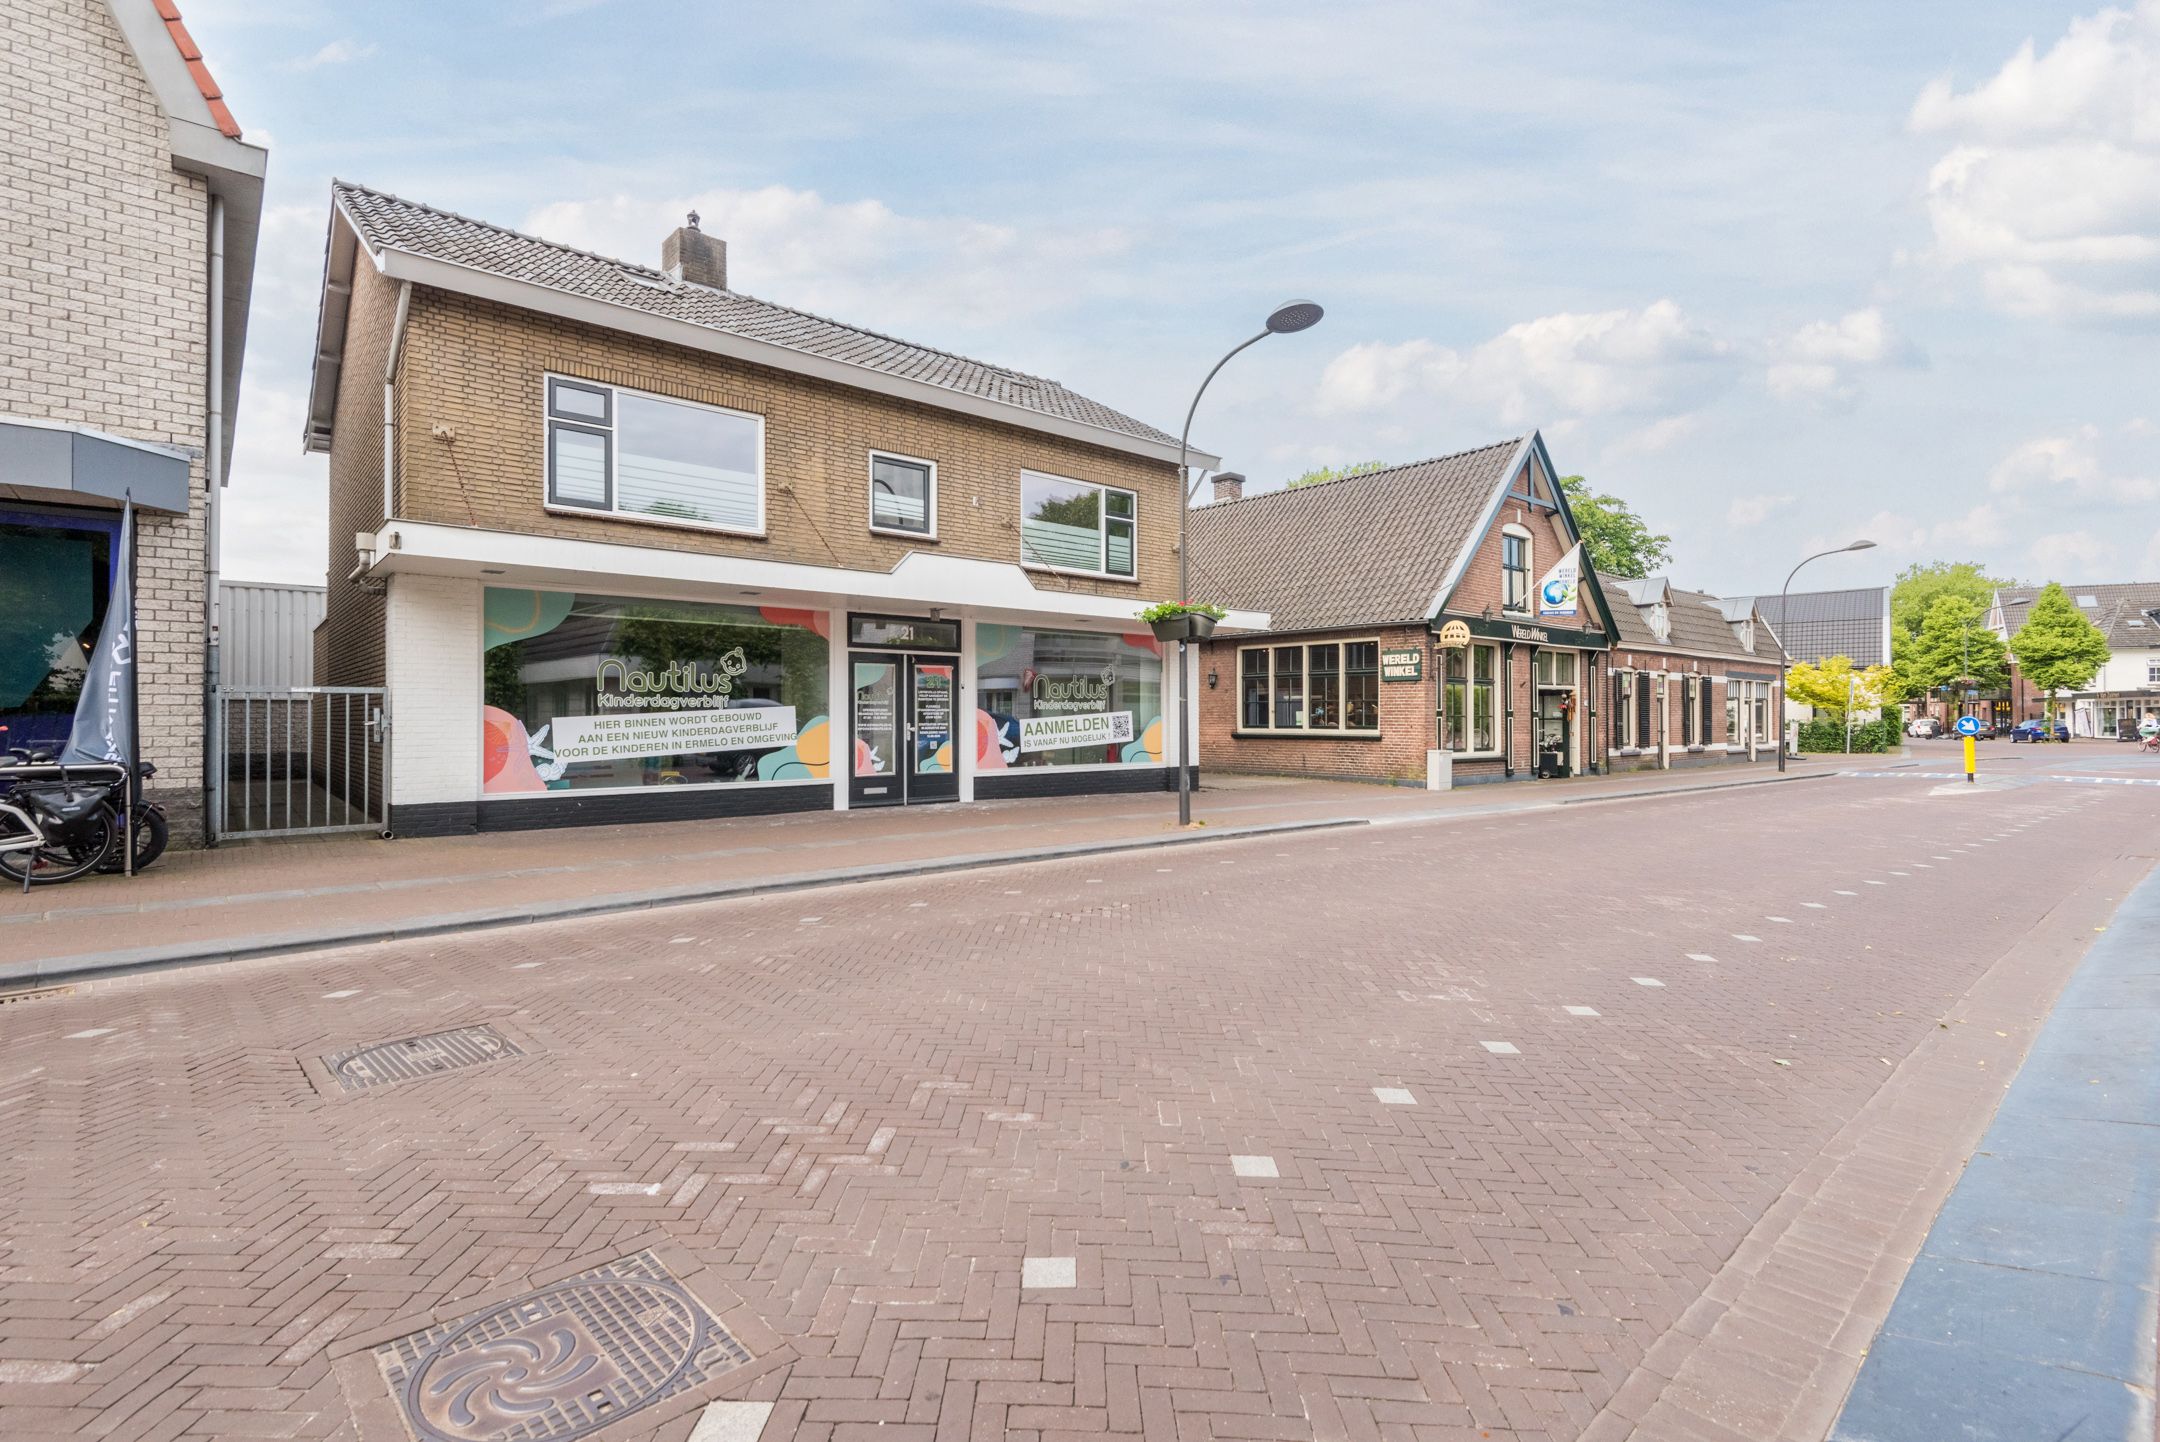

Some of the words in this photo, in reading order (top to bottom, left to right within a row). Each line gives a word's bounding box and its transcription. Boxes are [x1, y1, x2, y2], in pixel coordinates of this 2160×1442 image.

[900, 625, 914, 641] 21
[1382, 653, 1420, 666] WERELD
[1383, 665, 1418, 677] WINKEL
[597, 693, 730, 710] Kinderdagverblijf
[1033, 699, 1106, 712] Kinderdagverblijf
[594, 720, 621, 730] HIER
[624, 717, 666, 728] BINNEN
[668, 715, 708, 725] WORDT
[710, 712, 762, 723] GEBOUWD
[1024, 716, 1109, 737] AANMELDEN
[578, 734, 603, 744] AAN
[606, 732, 630, 742] EEN
[632, 730, 669, 740] NIEUW
[671, 723, 778, 737] KINDERDAGVERBLIJF
[1024, 740, 1031, 748] IS
[1033, 737, 1058, 747] VANAF
[1059, 736, 1070, 744] NU
[1071, 733, 1107, 743] MOGELIJK
[554, 747, 589, 758] VOOR
[592, 746, 609, 755] DE
[611, 742, 669, 754] KINDEREN
[671, 741, 682, 750] IN
[685, 738, 728, 749] ERMELO
[730, 737, 744, 745] EN
[746, 732, 798, 744] OMGEVING
